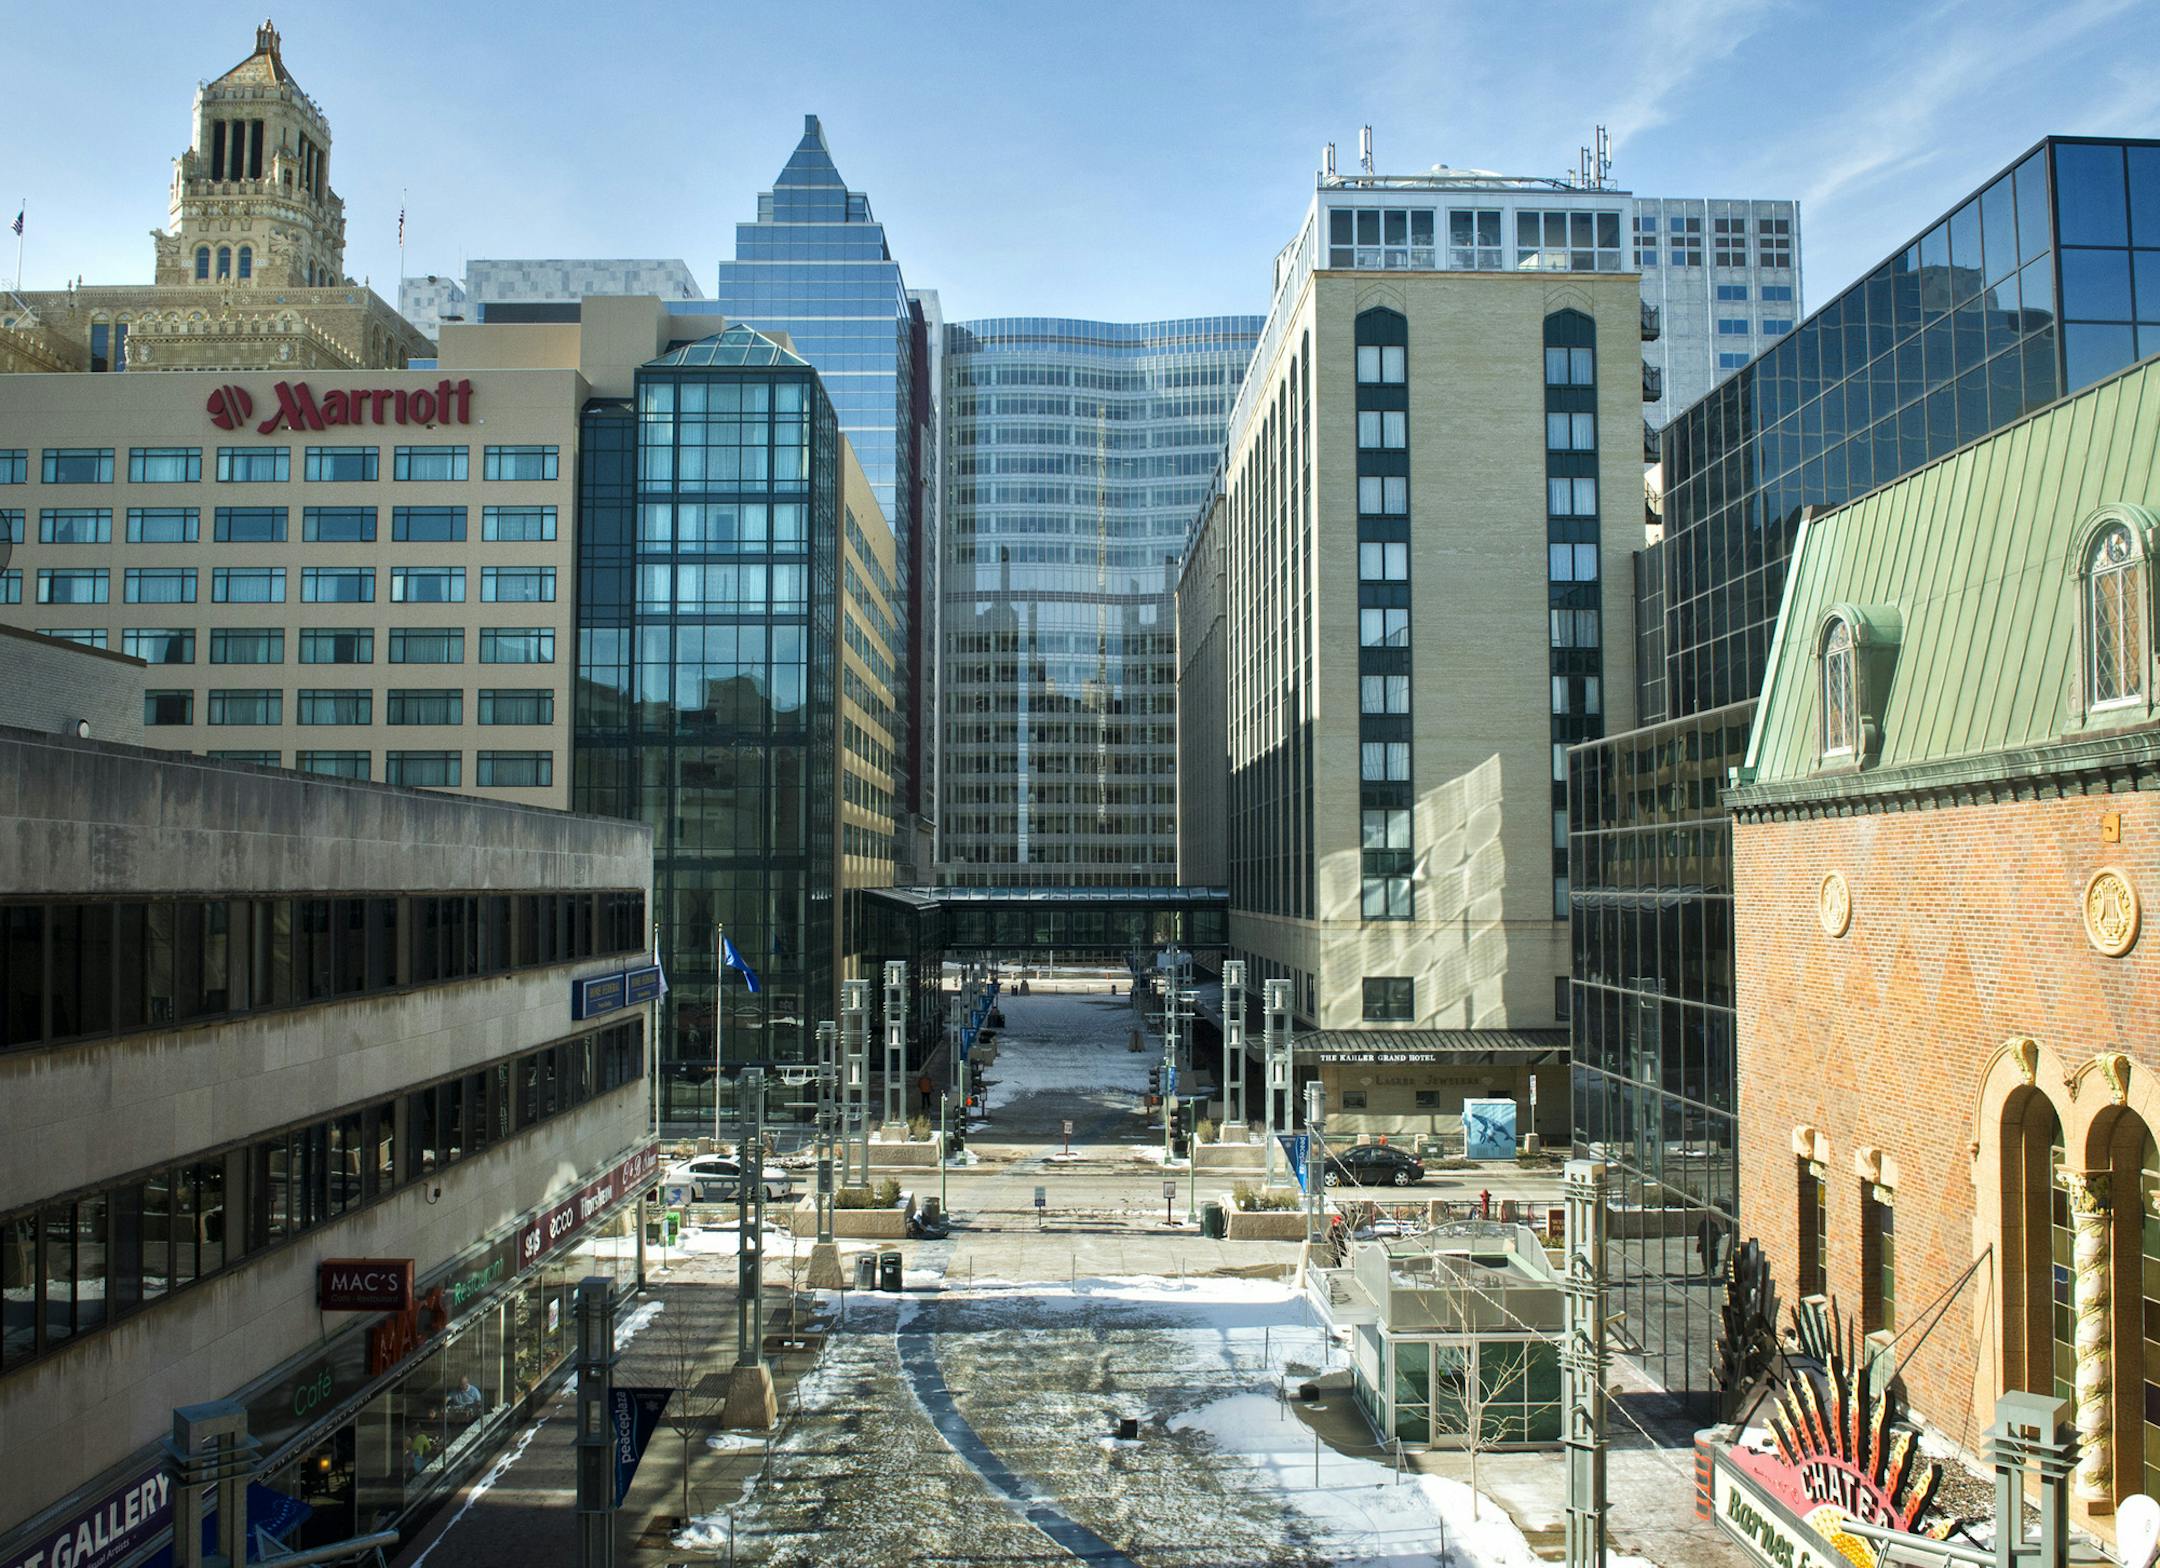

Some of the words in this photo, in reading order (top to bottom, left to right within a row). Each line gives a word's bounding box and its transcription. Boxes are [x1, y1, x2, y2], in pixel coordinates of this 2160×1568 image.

[257, 378, 473, 434] Marriott
[550, 1207, 574, 1239] ecco
[331, 1272, 398, 1291] MAC'S
[453, 1257, 504, 1305] Restaurant
[294, 1367, 332, 1416] Café
[615, 1391, 635, 1464] peaceplaza
[52, 1472, 170, 1568] GALLERY
[1727, 1486, 1794, 1568] Barnes
